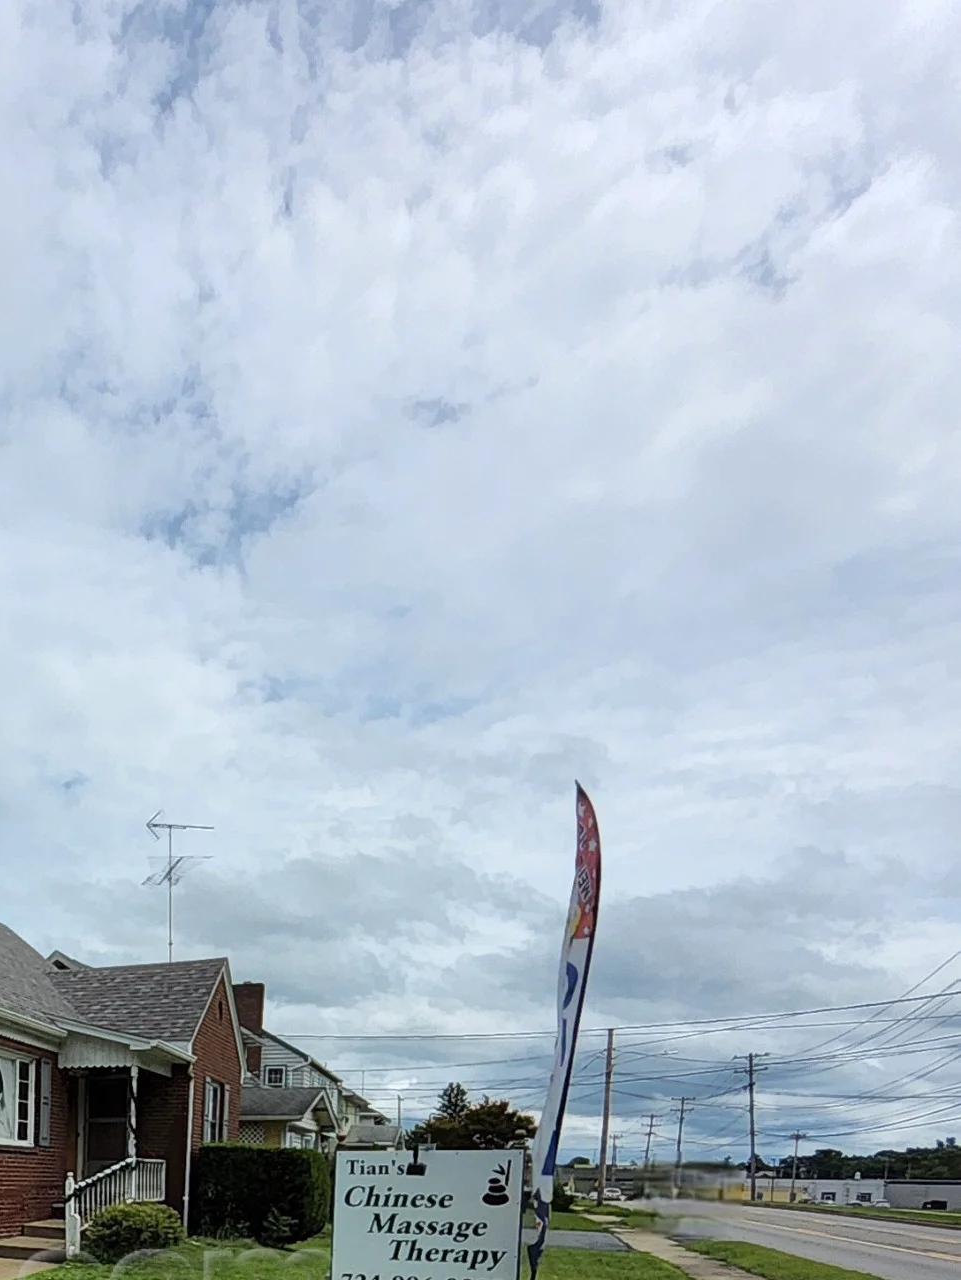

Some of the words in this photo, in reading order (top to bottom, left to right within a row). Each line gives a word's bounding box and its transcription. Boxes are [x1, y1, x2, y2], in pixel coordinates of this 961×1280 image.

[346, 1159, 406, 1176] Tian's
[344, 1185, 454, 1209] Chinese
[367, 1212, 488, 1243] Massage
[388, 1239, 508, 1272] Therapy
